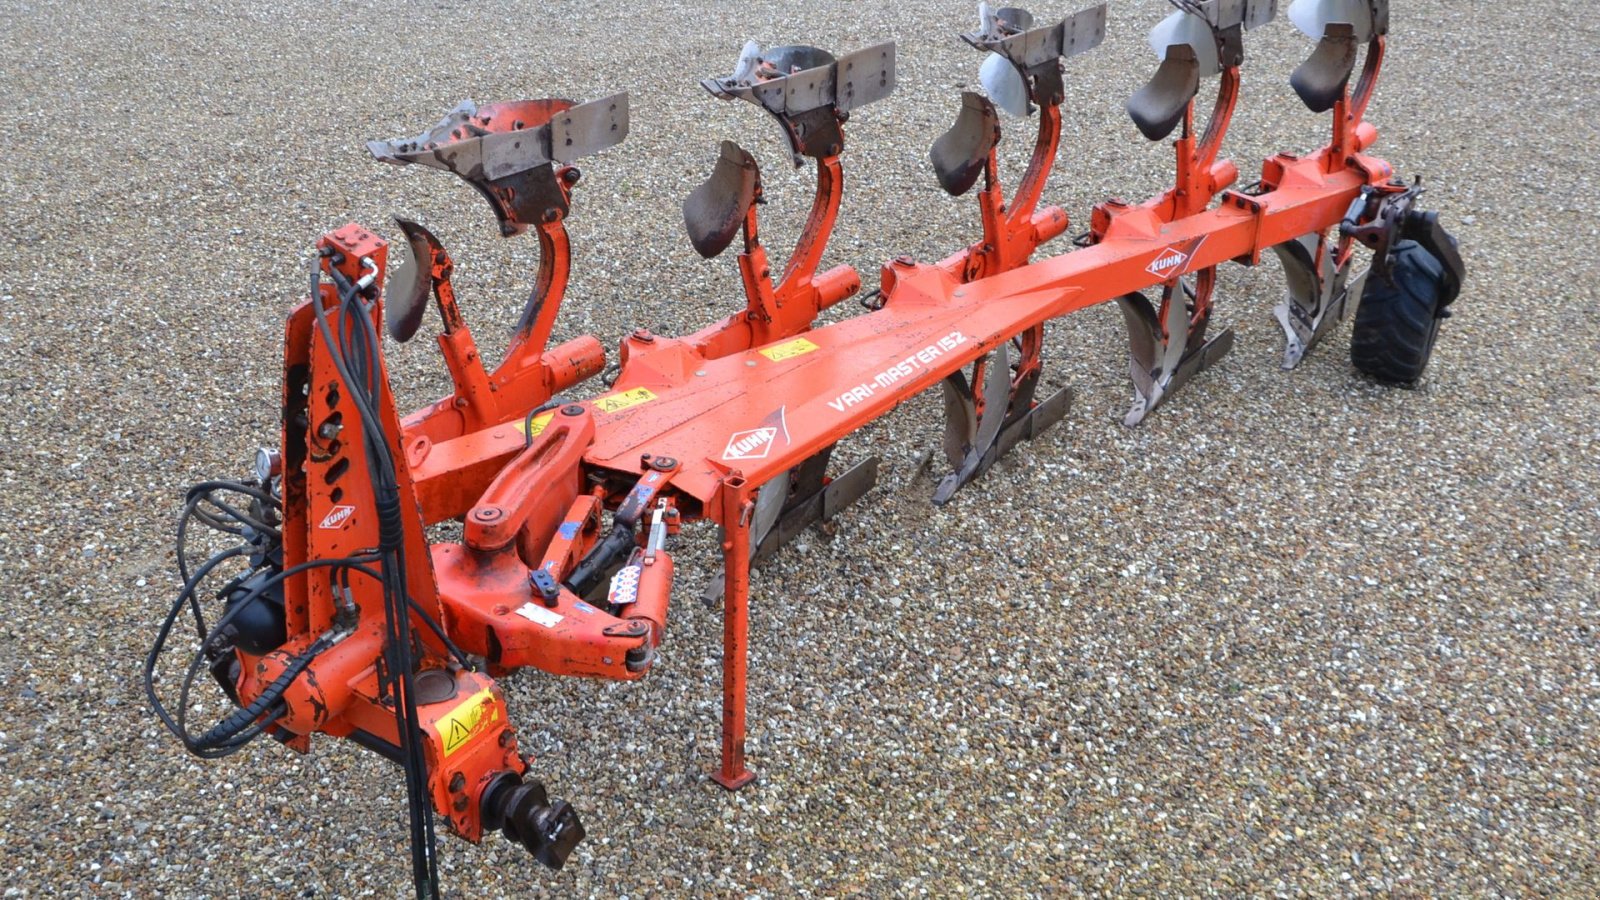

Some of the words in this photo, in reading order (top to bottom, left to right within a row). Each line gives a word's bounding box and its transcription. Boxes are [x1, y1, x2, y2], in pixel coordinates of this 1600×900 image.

[1151, 254, 1182, 272] KUHN
[828, 345, 943, 411] VARI-MASTER
[937, 331, 967, 351] 152
[728, 429, 772, 457] KUHN
[324, 507, 351, 527] KUHN
